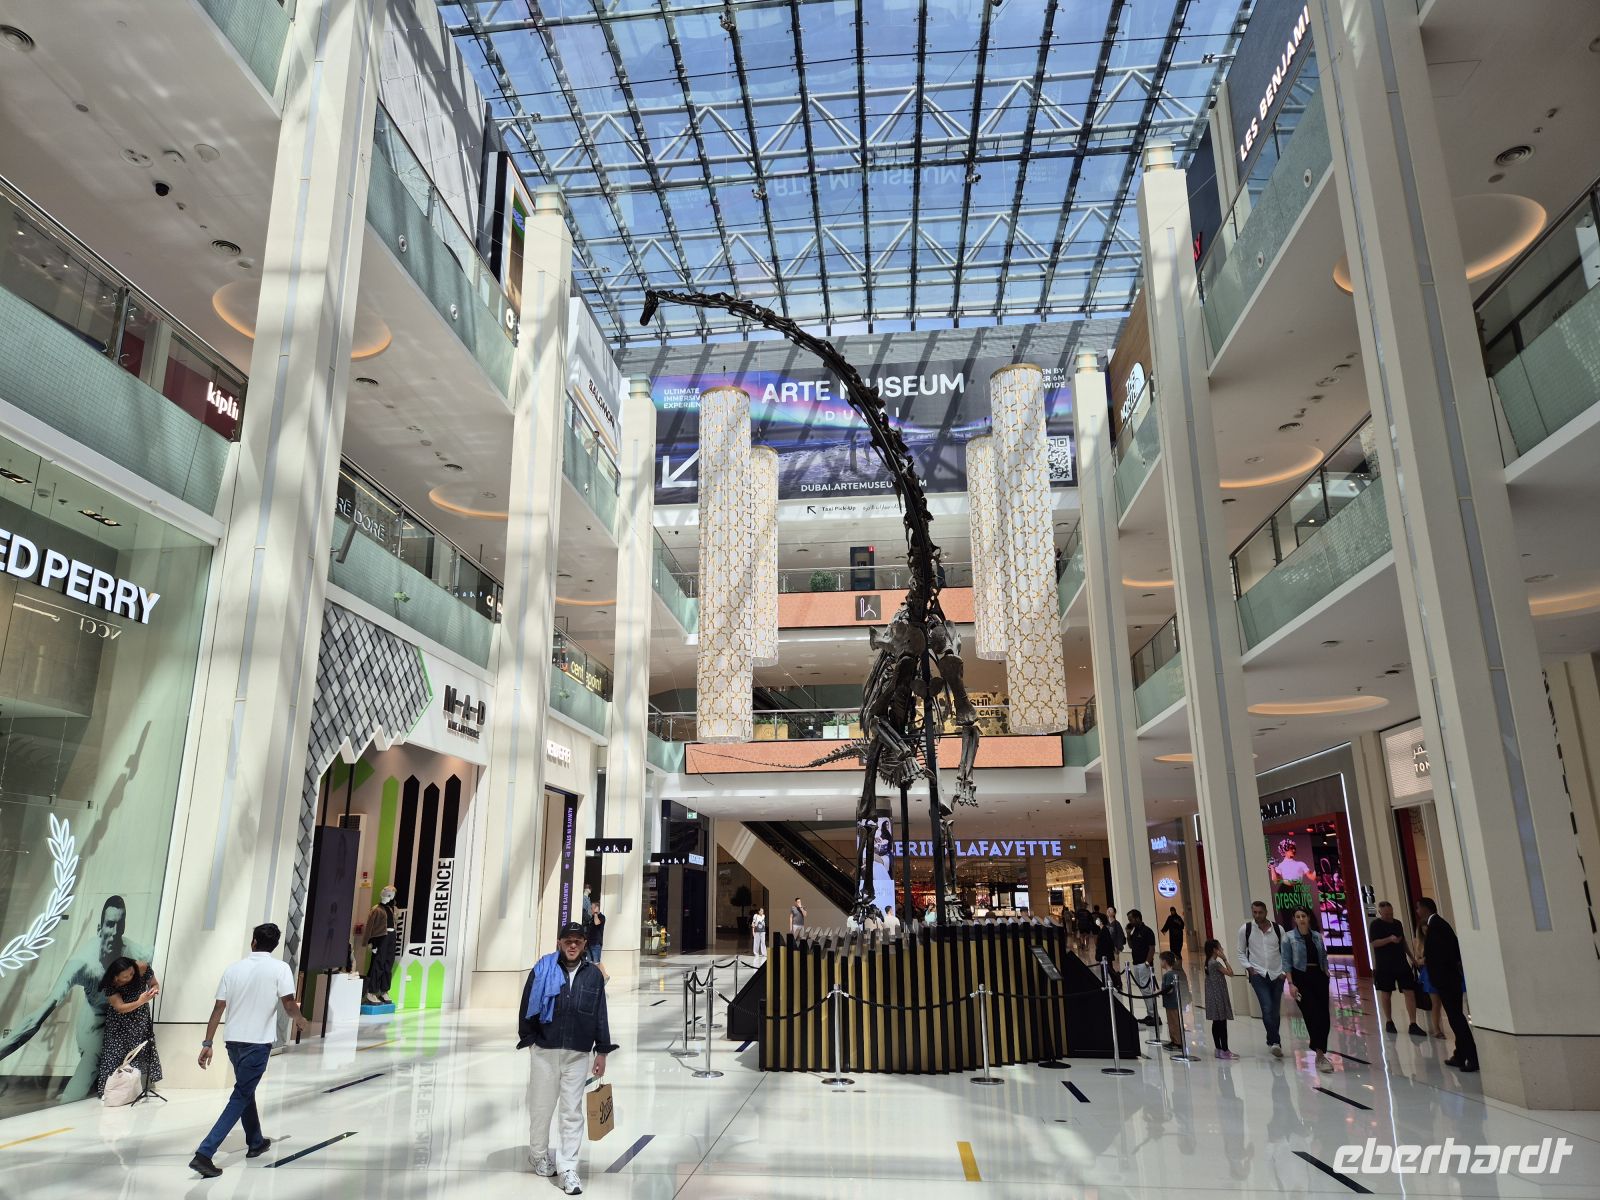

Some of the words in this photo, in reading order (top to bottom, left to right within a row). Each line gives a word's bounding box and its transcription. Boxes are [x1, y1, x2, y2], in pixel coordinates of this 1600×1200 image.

[1240, 117, 1259, 162] LES
[663, 387, 701, 395] ULTIMATE
[761, 380, 831, 404] ARTE
[825, 406, 900, 422] DUI
[40, 548, 161, 625] PERRY
[954, 839, 1062, 858] LAFAYETTE
[430, 859, 452, 957] DIFFERENCE
[408, 946, 423, 957] A
